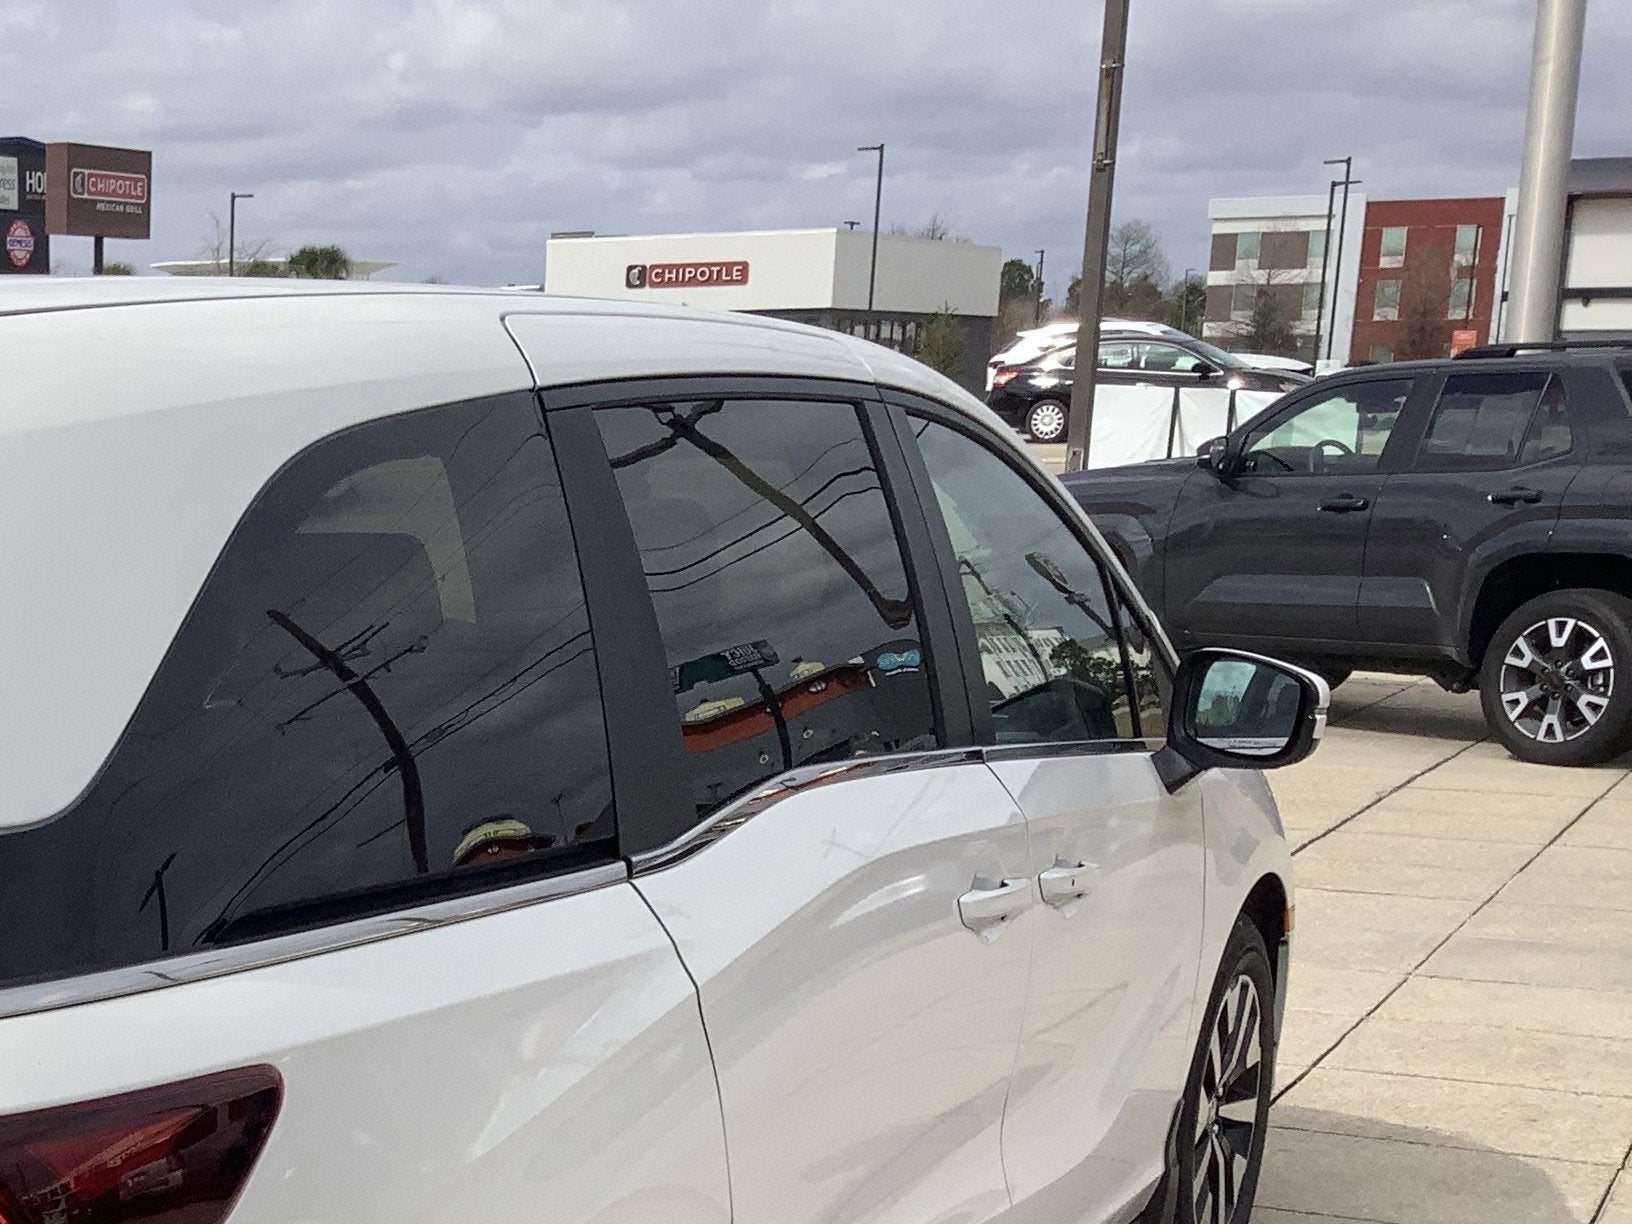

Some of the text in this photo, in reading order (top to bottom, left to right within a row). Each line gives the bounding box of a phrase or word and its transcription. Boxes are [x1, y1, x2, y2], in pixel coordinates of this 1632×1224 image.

[26, 170, 47, 193] HO
[88, 177, 144, 196] CHIPOTLE
[651, 265, 744, 283] CHIPOTLE
